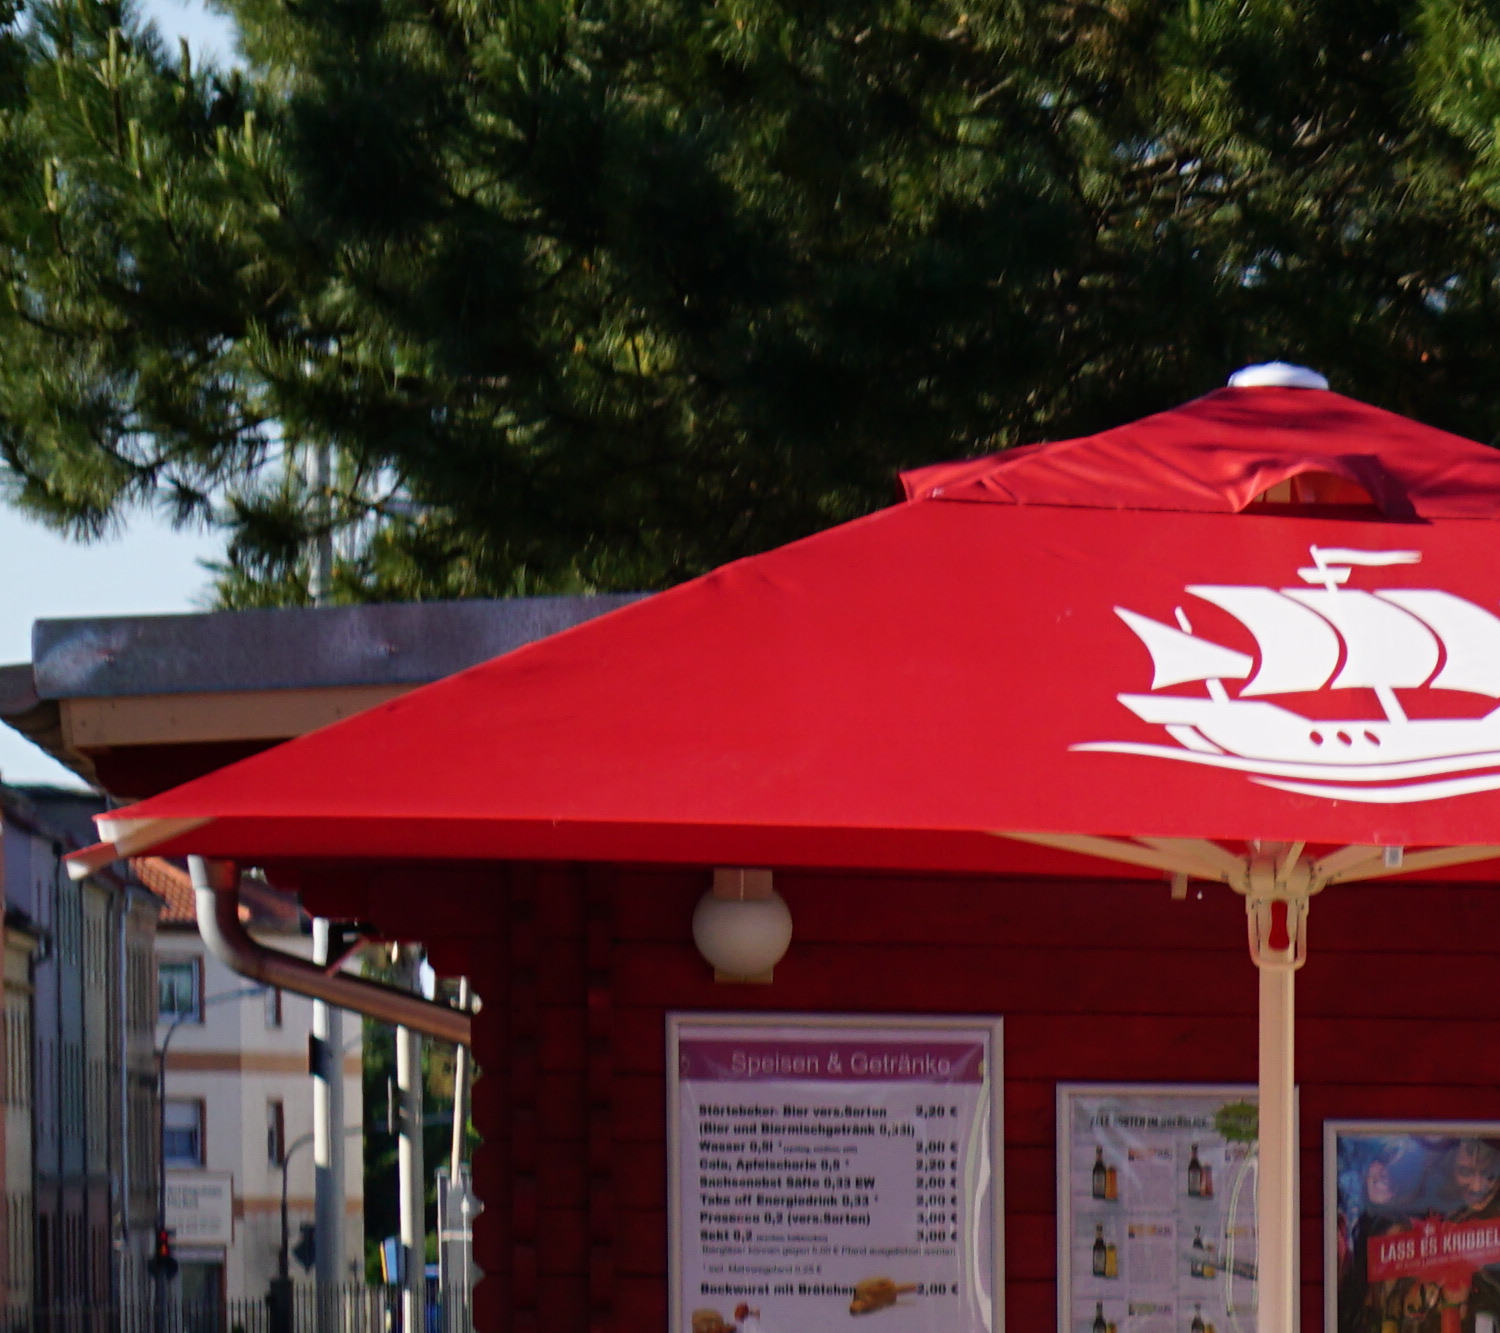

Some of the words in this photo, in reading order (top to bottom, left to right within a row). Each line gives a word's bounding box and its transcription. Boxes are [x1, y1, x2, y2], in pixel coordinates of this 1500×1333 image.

[731, 1050, 819, 1076] Speisen
[827, 1051, 842, 1073] &
[851, 1050, 951, 1075] Getränke
[783, 1105, 808, 1118] Bier
[733, 1123, 757, 1136] und
[699, 1141, 745, 1153] Wasser
[700, 1194, 731, 1207] Take
[735, 1194, 752, 1207] off
[756, 1194, 838, 1209] Energiedrink
[700, 1212, 760, 1225] Prosecco
[700, 1230, 729, 1243] Sekt
[1380, 1240, 1415, 1264] LASS
[1420, 1236, 1437, 1258] ES
[700, 1282, 769, 1296] Bockwurst
[774, 1282, 794, 1295] mit
[798, 1282, 857, 1296] Brötchen
